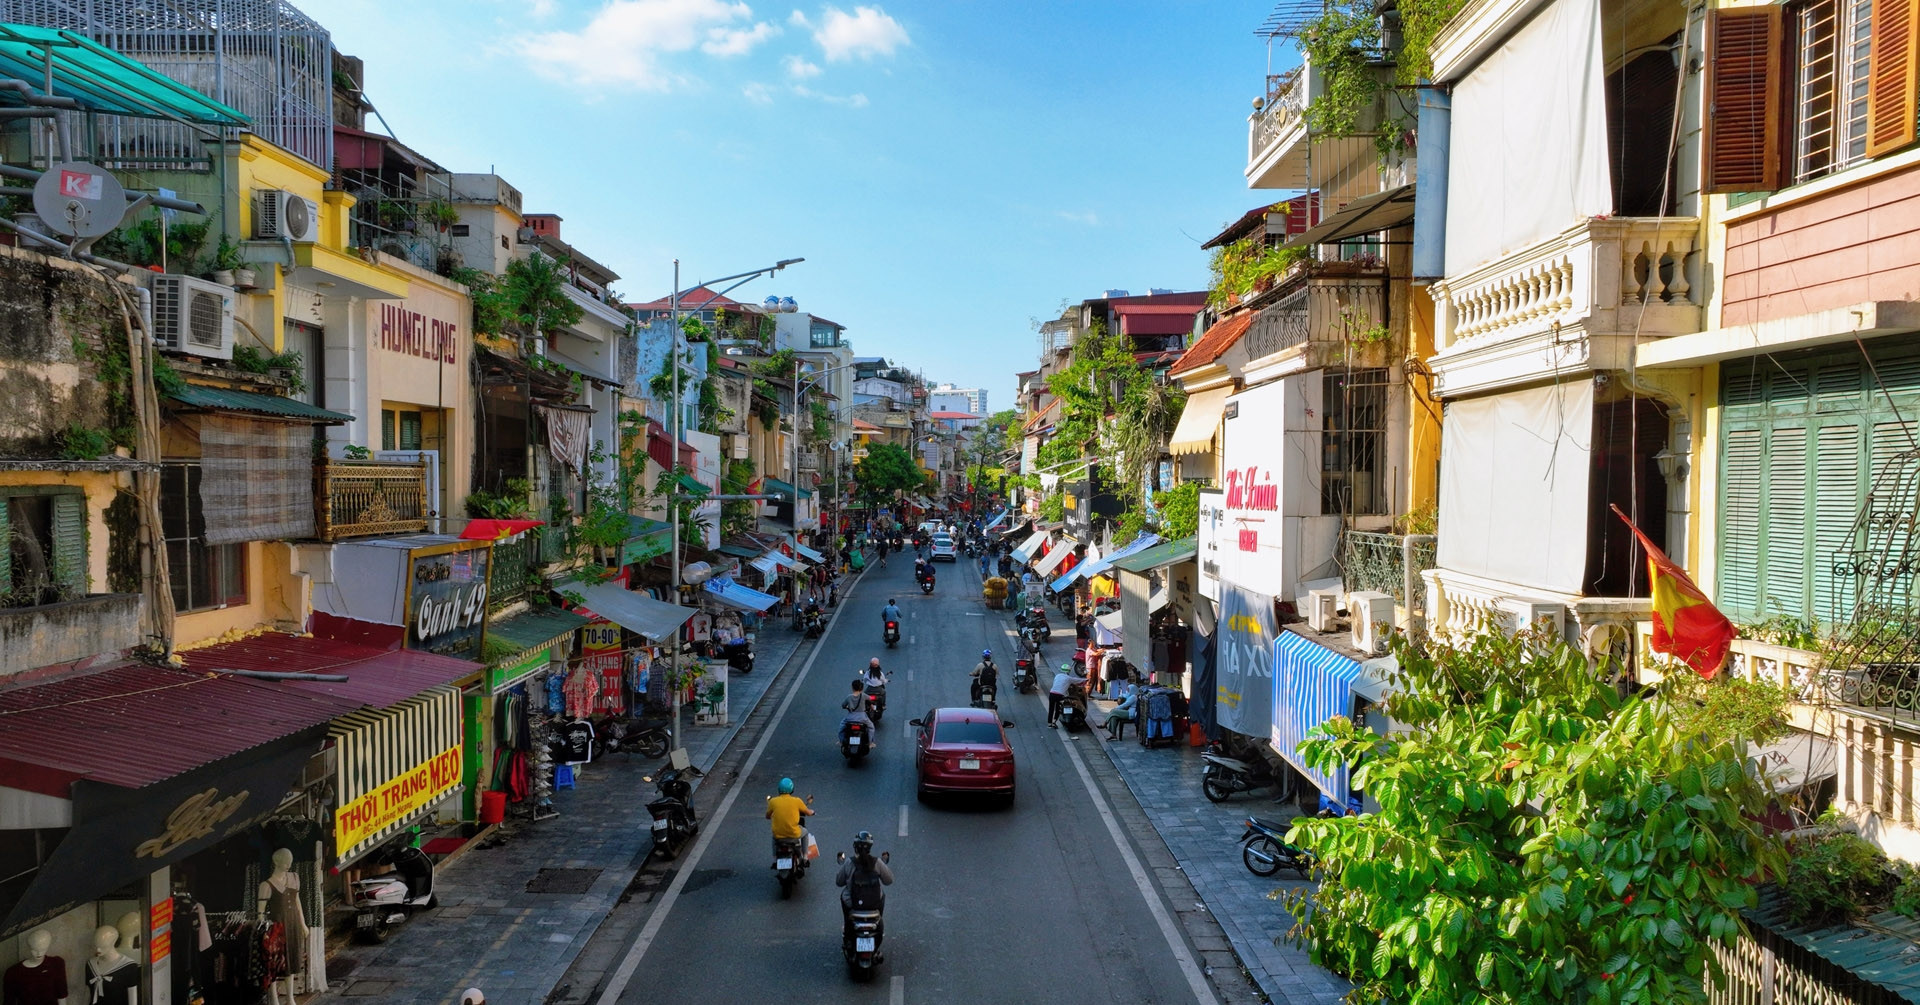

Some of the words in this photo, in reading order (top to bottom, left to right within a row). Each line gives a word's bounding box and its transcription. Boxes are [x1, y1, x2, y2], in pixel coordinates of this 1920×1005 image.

[464, 583, 486, 629] 42
[340, 794, 378, 836] THỜI
[382, 769, 427, 810] TRANG
